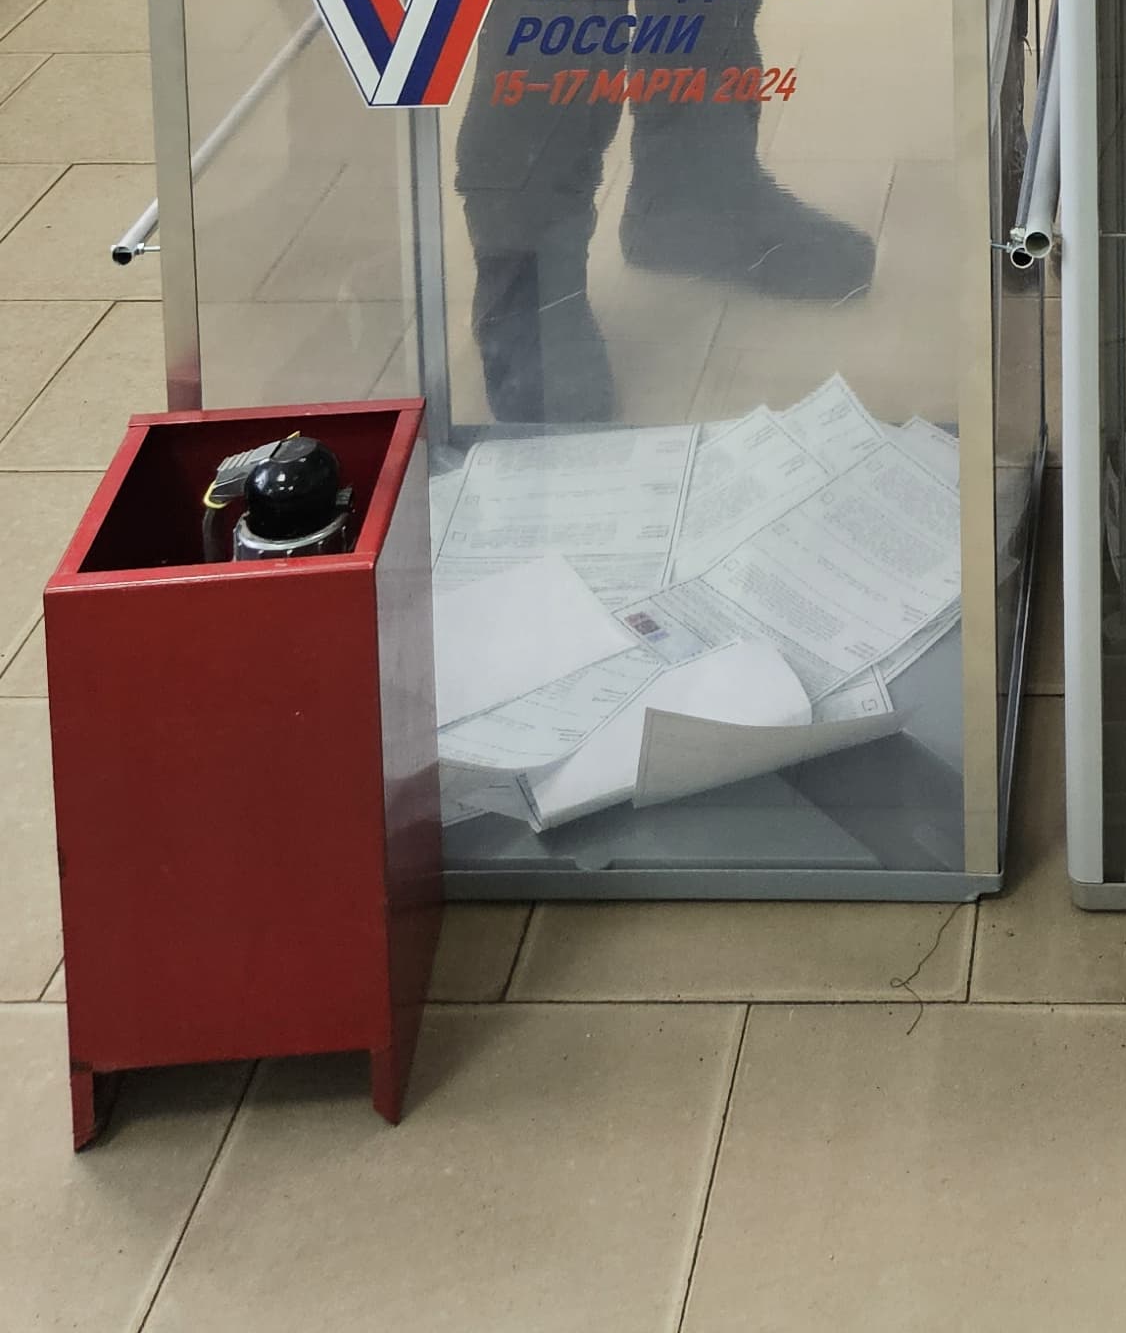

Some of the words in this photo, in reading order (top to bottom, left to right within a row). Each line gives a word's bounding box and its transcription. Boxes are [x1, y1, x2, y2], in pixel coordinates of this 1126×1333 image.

[507, 14, 705, 56] РОССИИ
[592, 68, 706, 104] МАРТА
[712, 67, 798, 103] 2024
